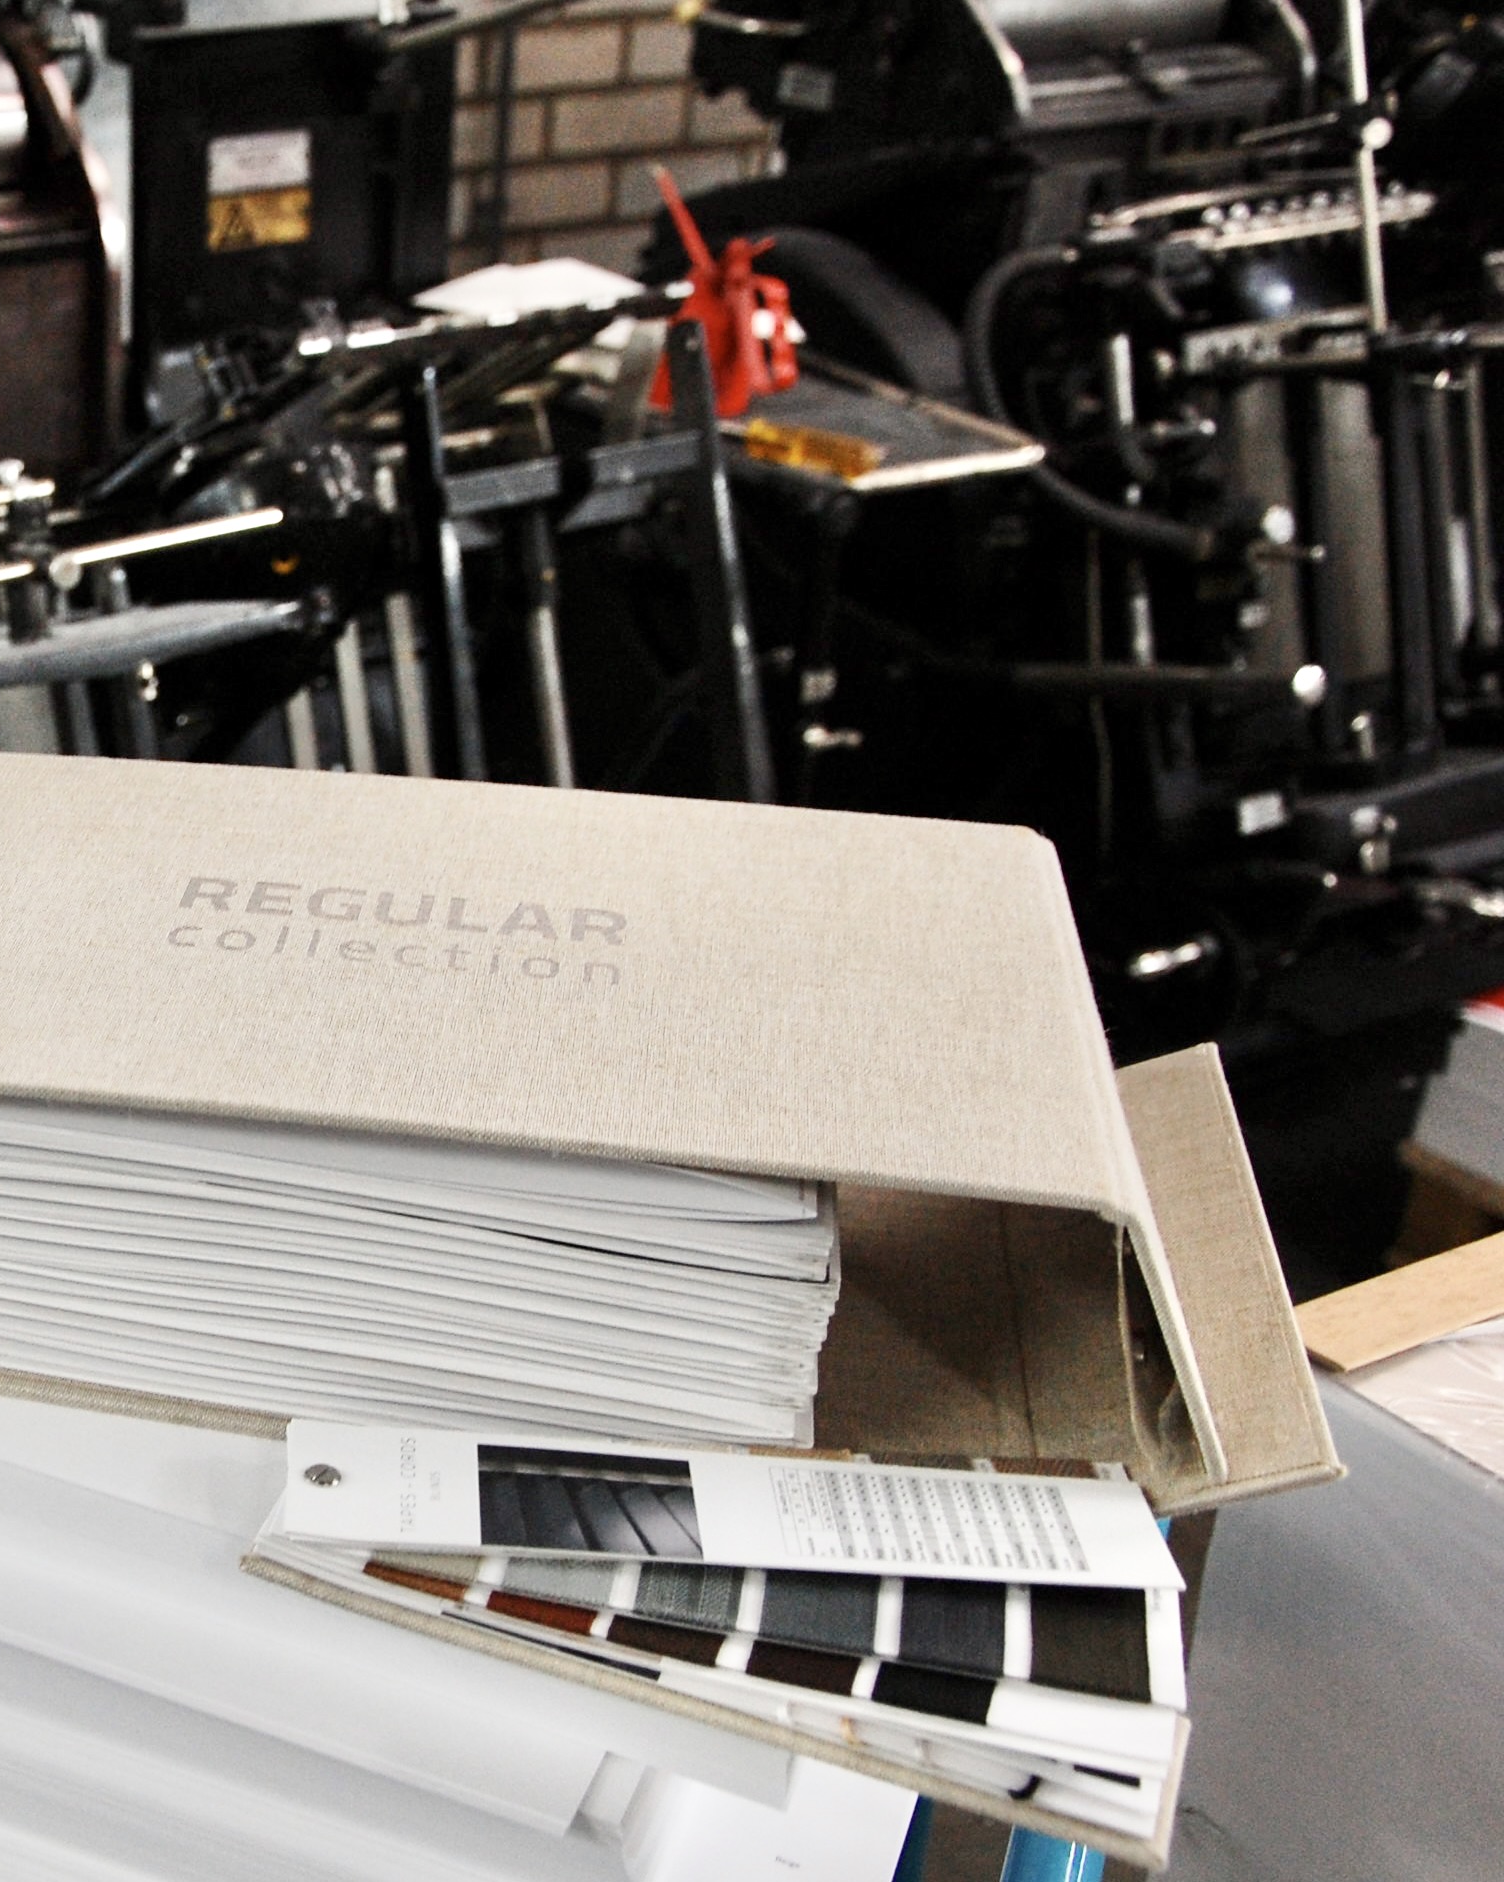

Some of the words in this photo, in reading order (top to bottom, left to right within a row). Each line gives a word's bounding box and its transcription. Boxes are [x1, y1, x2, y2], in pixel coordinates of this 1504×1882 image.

[178, 876, 628, 946] REGULAR
[167, 925, 622, 986] collection
[399, 1436, 416, 1479] CORDS
